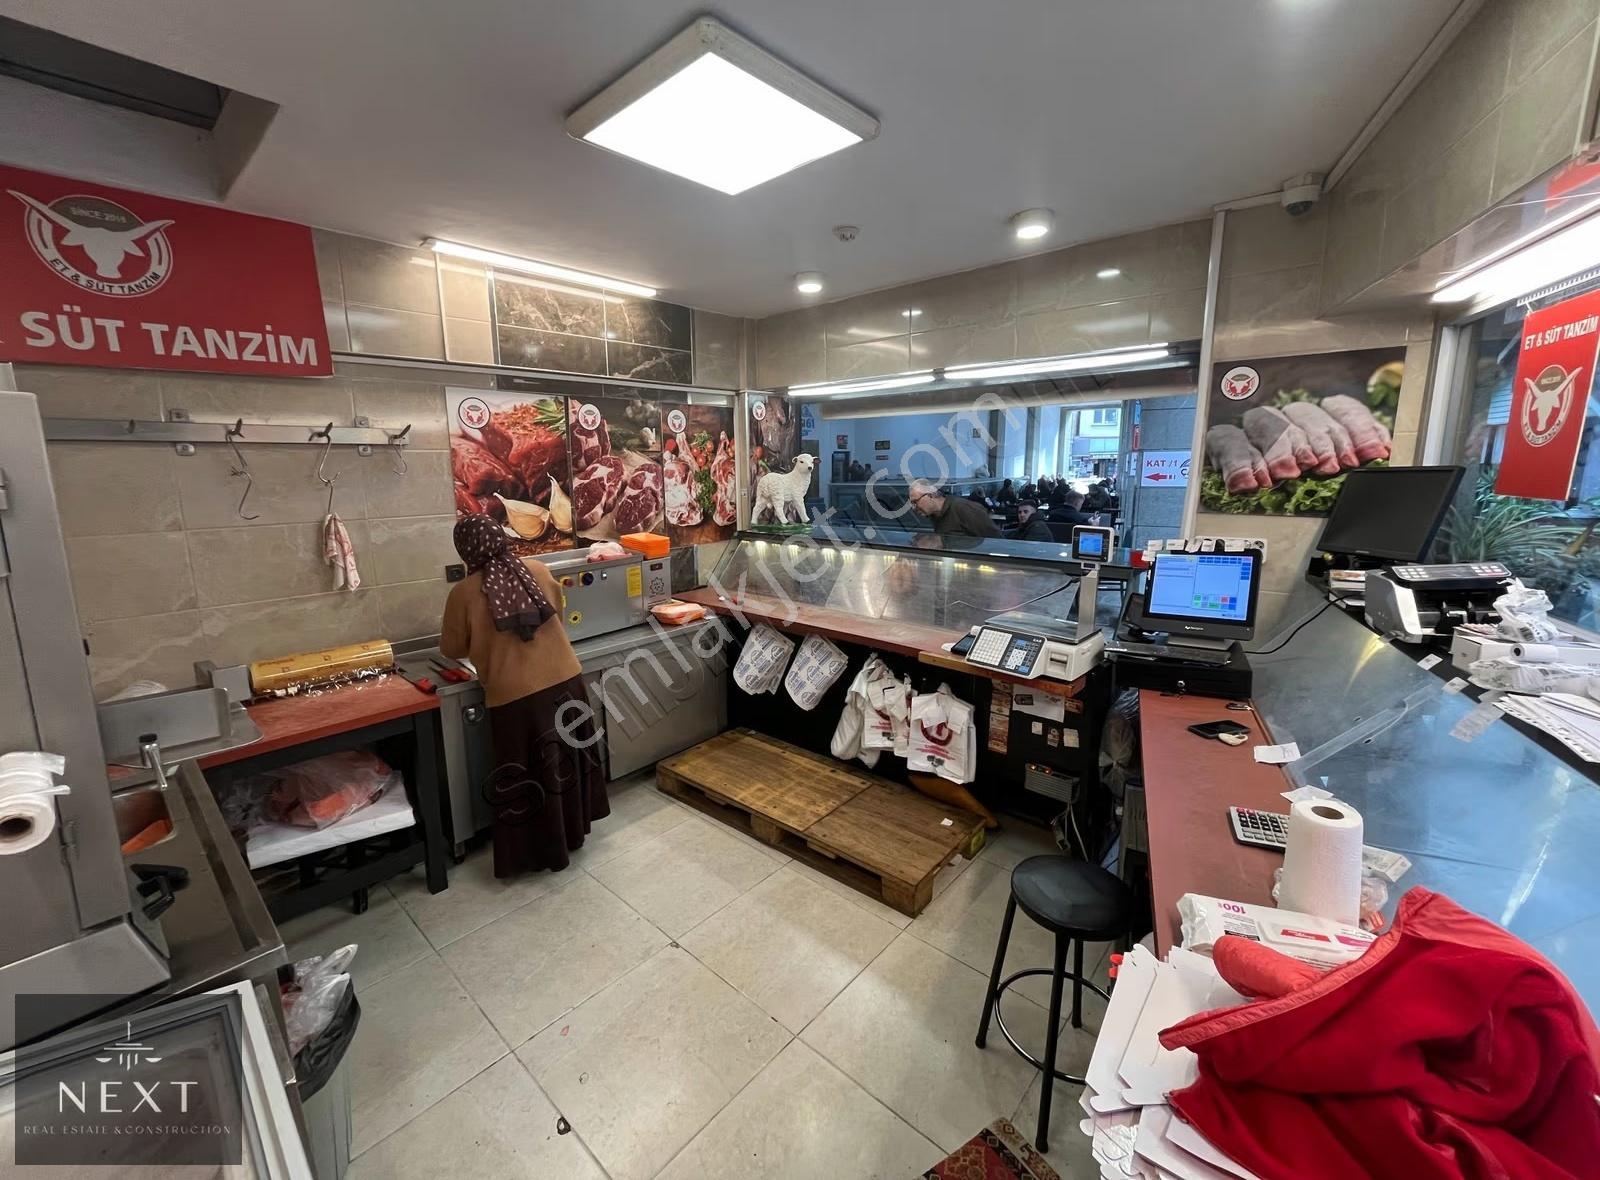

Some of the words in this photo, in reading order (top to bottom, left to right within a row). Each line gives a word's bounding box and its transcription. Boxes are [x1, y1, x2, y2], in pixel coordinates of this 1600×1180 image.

[50, 258, 70, 272] ET
[20, 304, 125, 353] SÜT
[141, 324, 319, 366] TANZİM
[1524, 334, 1536, 350] ET
[1145, 459, 1166, 467] KAT
